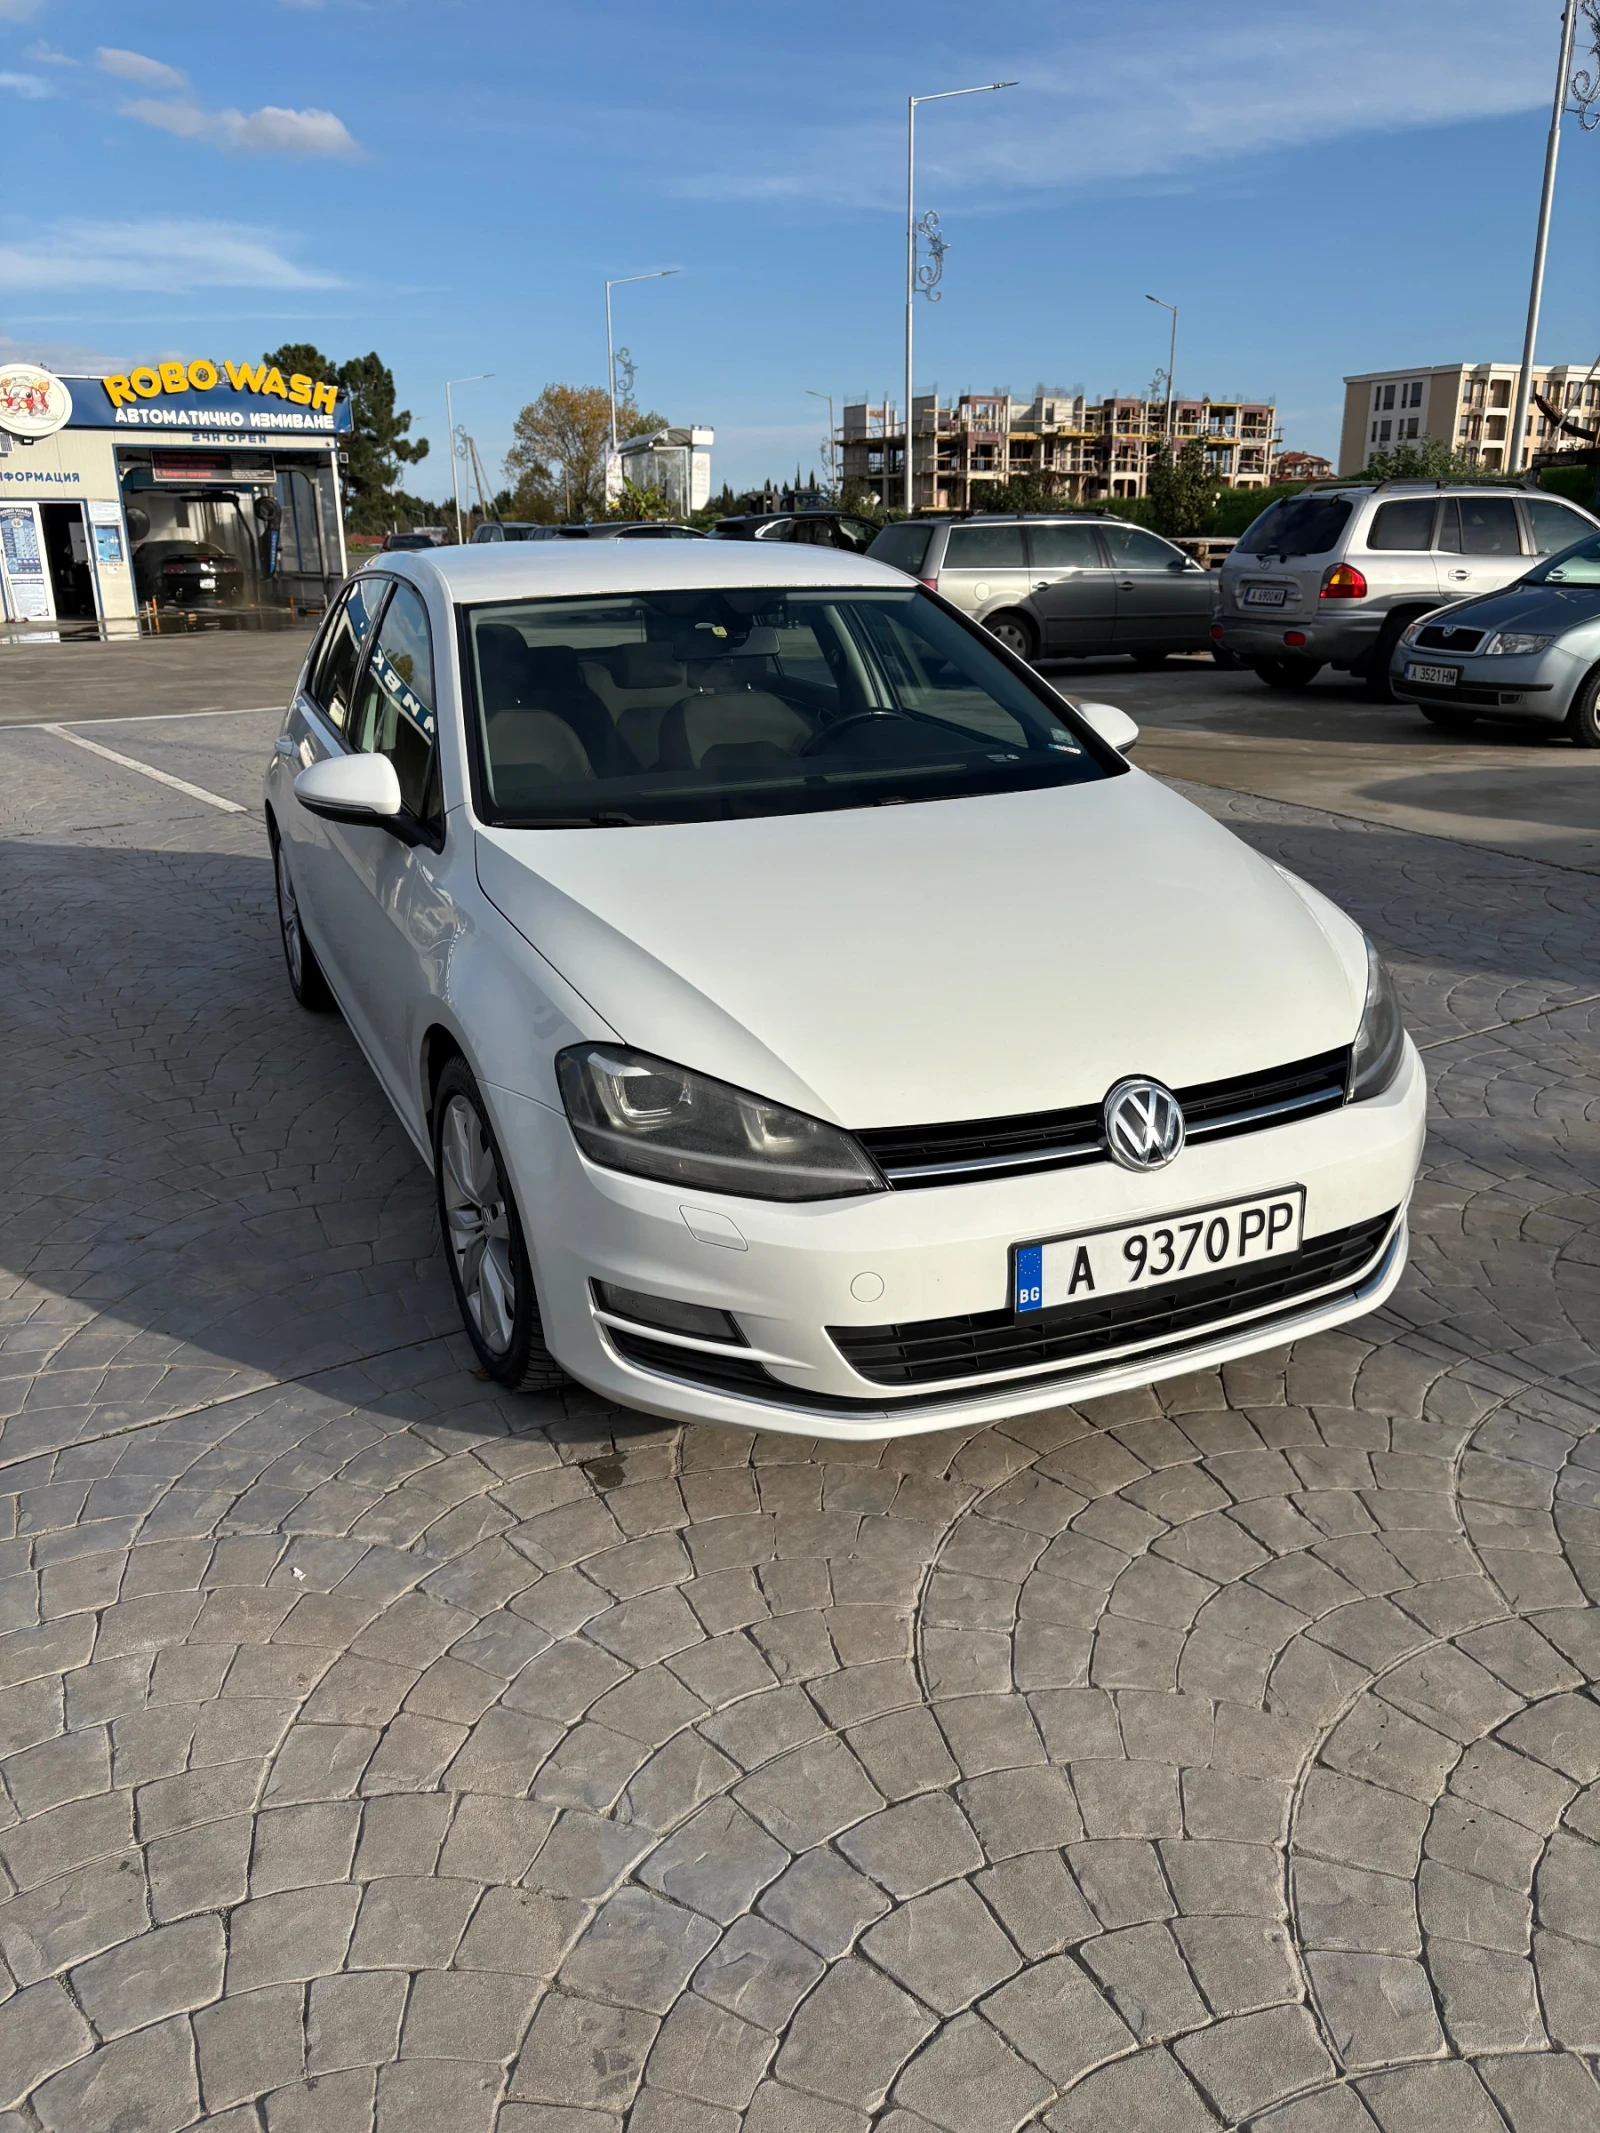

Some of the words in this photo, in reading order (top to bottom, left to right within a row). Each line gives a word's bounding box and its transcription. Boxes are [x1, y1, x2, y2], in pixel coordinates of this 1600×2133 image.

[103, 360, 217, 407] ROBO
[224, 360, 338, 414] WASH
[115, 408, 244, 427] АВТОМАТИЧНО
[250, 412, 335, 429] ИЗМИВАНЕ
[226, 433, 267, 444] OPEN
[1411, 666, 1417, 679] A
[1067, 1245, 1095, 1295] A
[1019, 1286, 1040, 1304] BG
